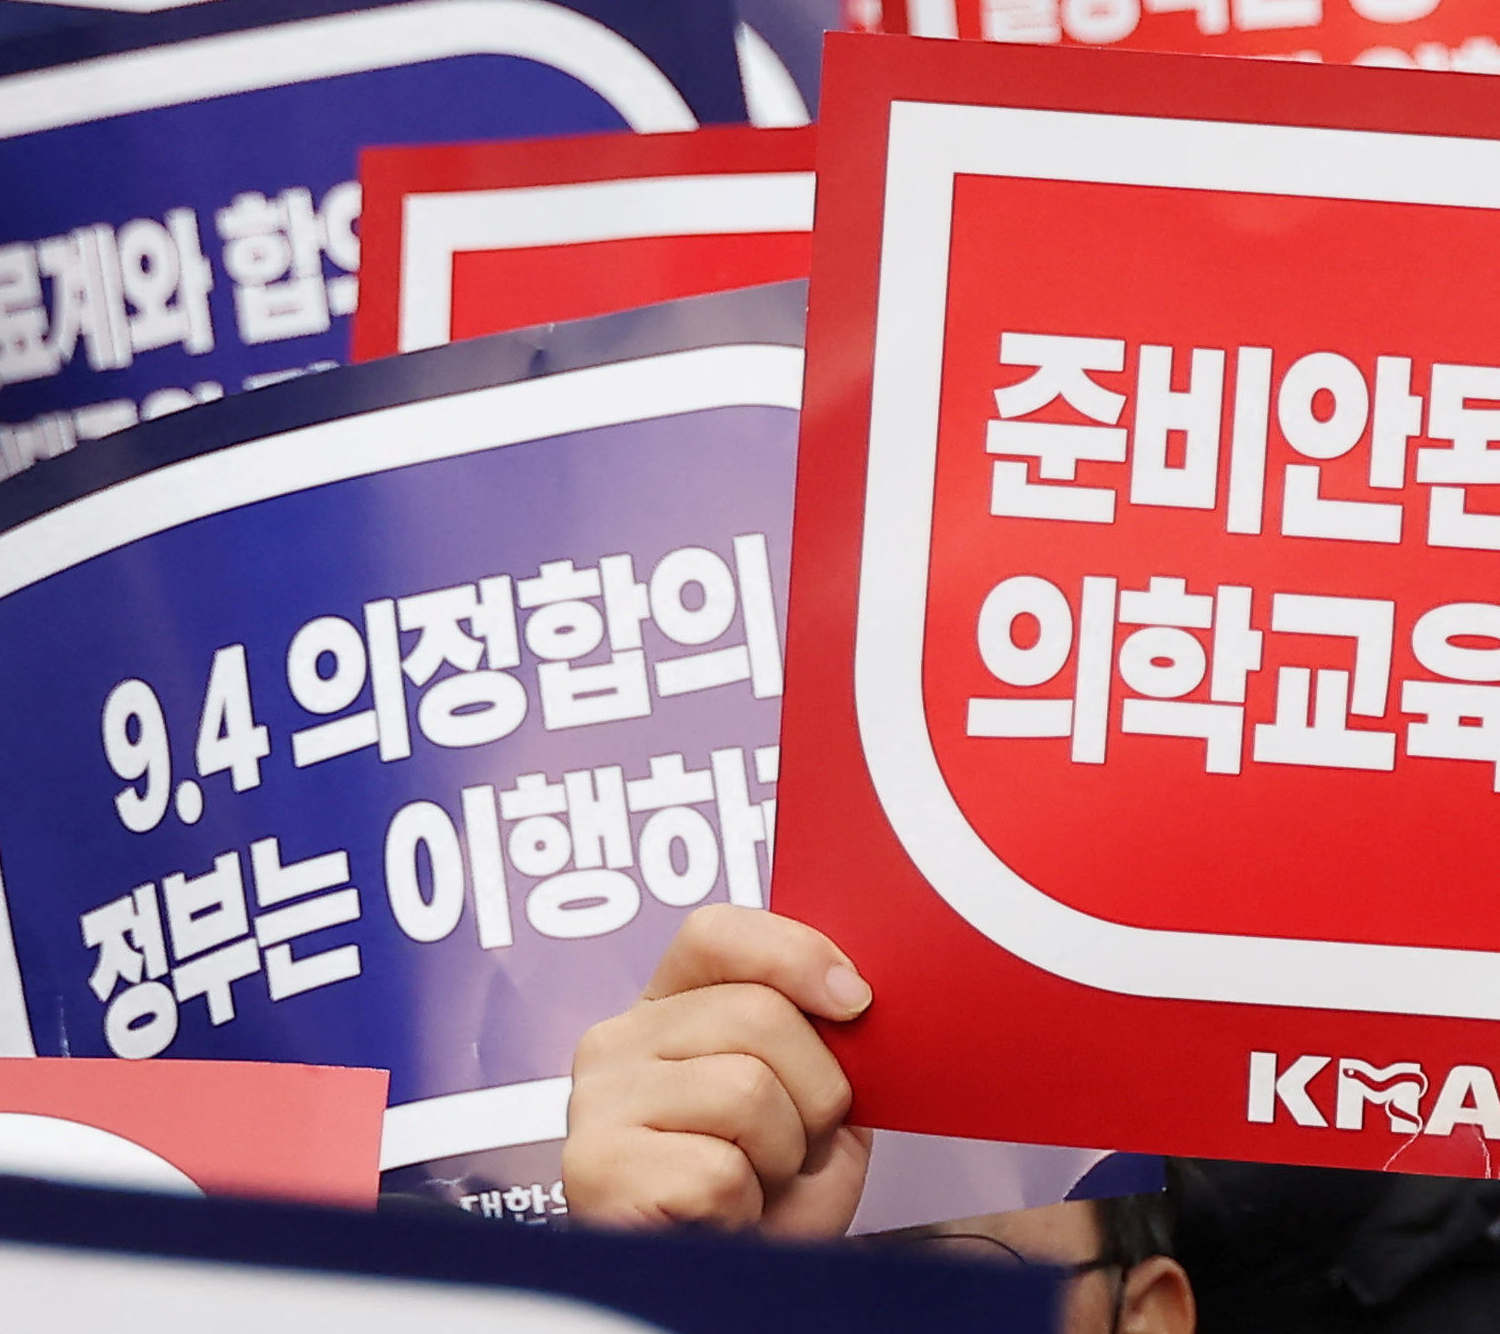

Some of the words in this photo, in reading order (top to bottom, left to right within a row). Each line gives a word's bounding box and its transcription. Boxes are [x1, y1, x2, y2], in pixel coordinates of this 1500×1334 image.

[101, 645, 271, 833] 9.4
[285, 533, 784, 768] 의정합의
[79, 836, 363, 1061] 정부는
[383, 744, 779, 950] 이행하
